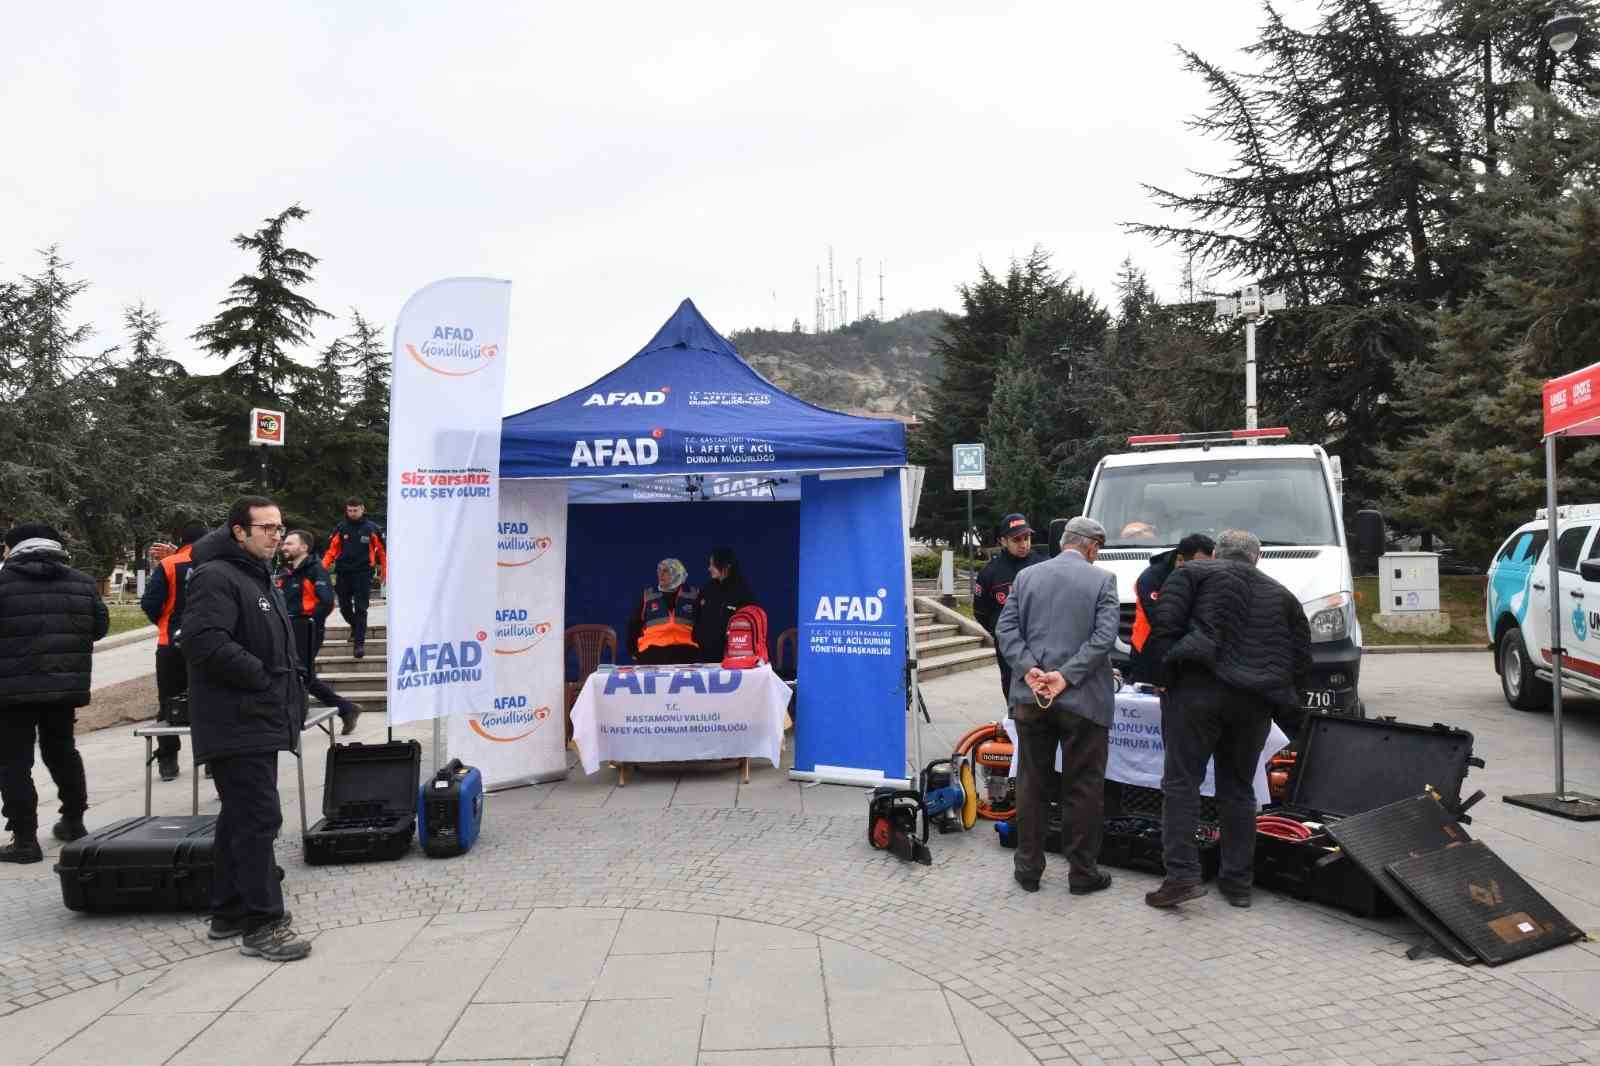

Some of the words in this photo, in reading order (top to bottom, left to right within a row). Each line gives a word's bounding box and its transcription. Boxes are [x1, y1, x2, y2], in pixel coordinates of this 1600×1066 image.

[433, 325, 474, 341] AFAD
[583, 391, 666, 407] AFAD
[570, 438, 659, 467] AFAD
[685, 443, 695, 453] İL
[701, 444, 726, 454] AFET
[731, 444, 745, 454] VE
[750, 443, 774, 453] ACİL
[686, 455, 718, 464] DURUM
[401, 471, 425, 486] Siz
[401, 487, 427, 499] ÇOK
[430, 487, 455, 500] ŞEY
[457, 486, 490, 498] OLUR!
[814, 595, 883, 621] AFAD
[810, 636, 828, 644] AFET
[846, 636, 863, 645] ACİL
[810, 645, 846, 654] YÖNETİMİ
[847, 646, 891, 655] BAŞKANLIĞI
[398, 641, 482, 676] AFAD
[397, 669, 482, 690] KASTAMONU
[603, 671, 743, 695] AFAD
[494, 696, 527, 709] AFAD
[1306, 691, 1330, 706] 710
[665, 703, 681, 711] T.C.
[1120, 707, 1142, 718] T.C.
[625, 714, 682, 723] KASTAMONU
[684, 713, 721, 722] VALİLİĞİ
[609, 726, 633, 735] AFET
[654, 725, 688, 734] DURUM
